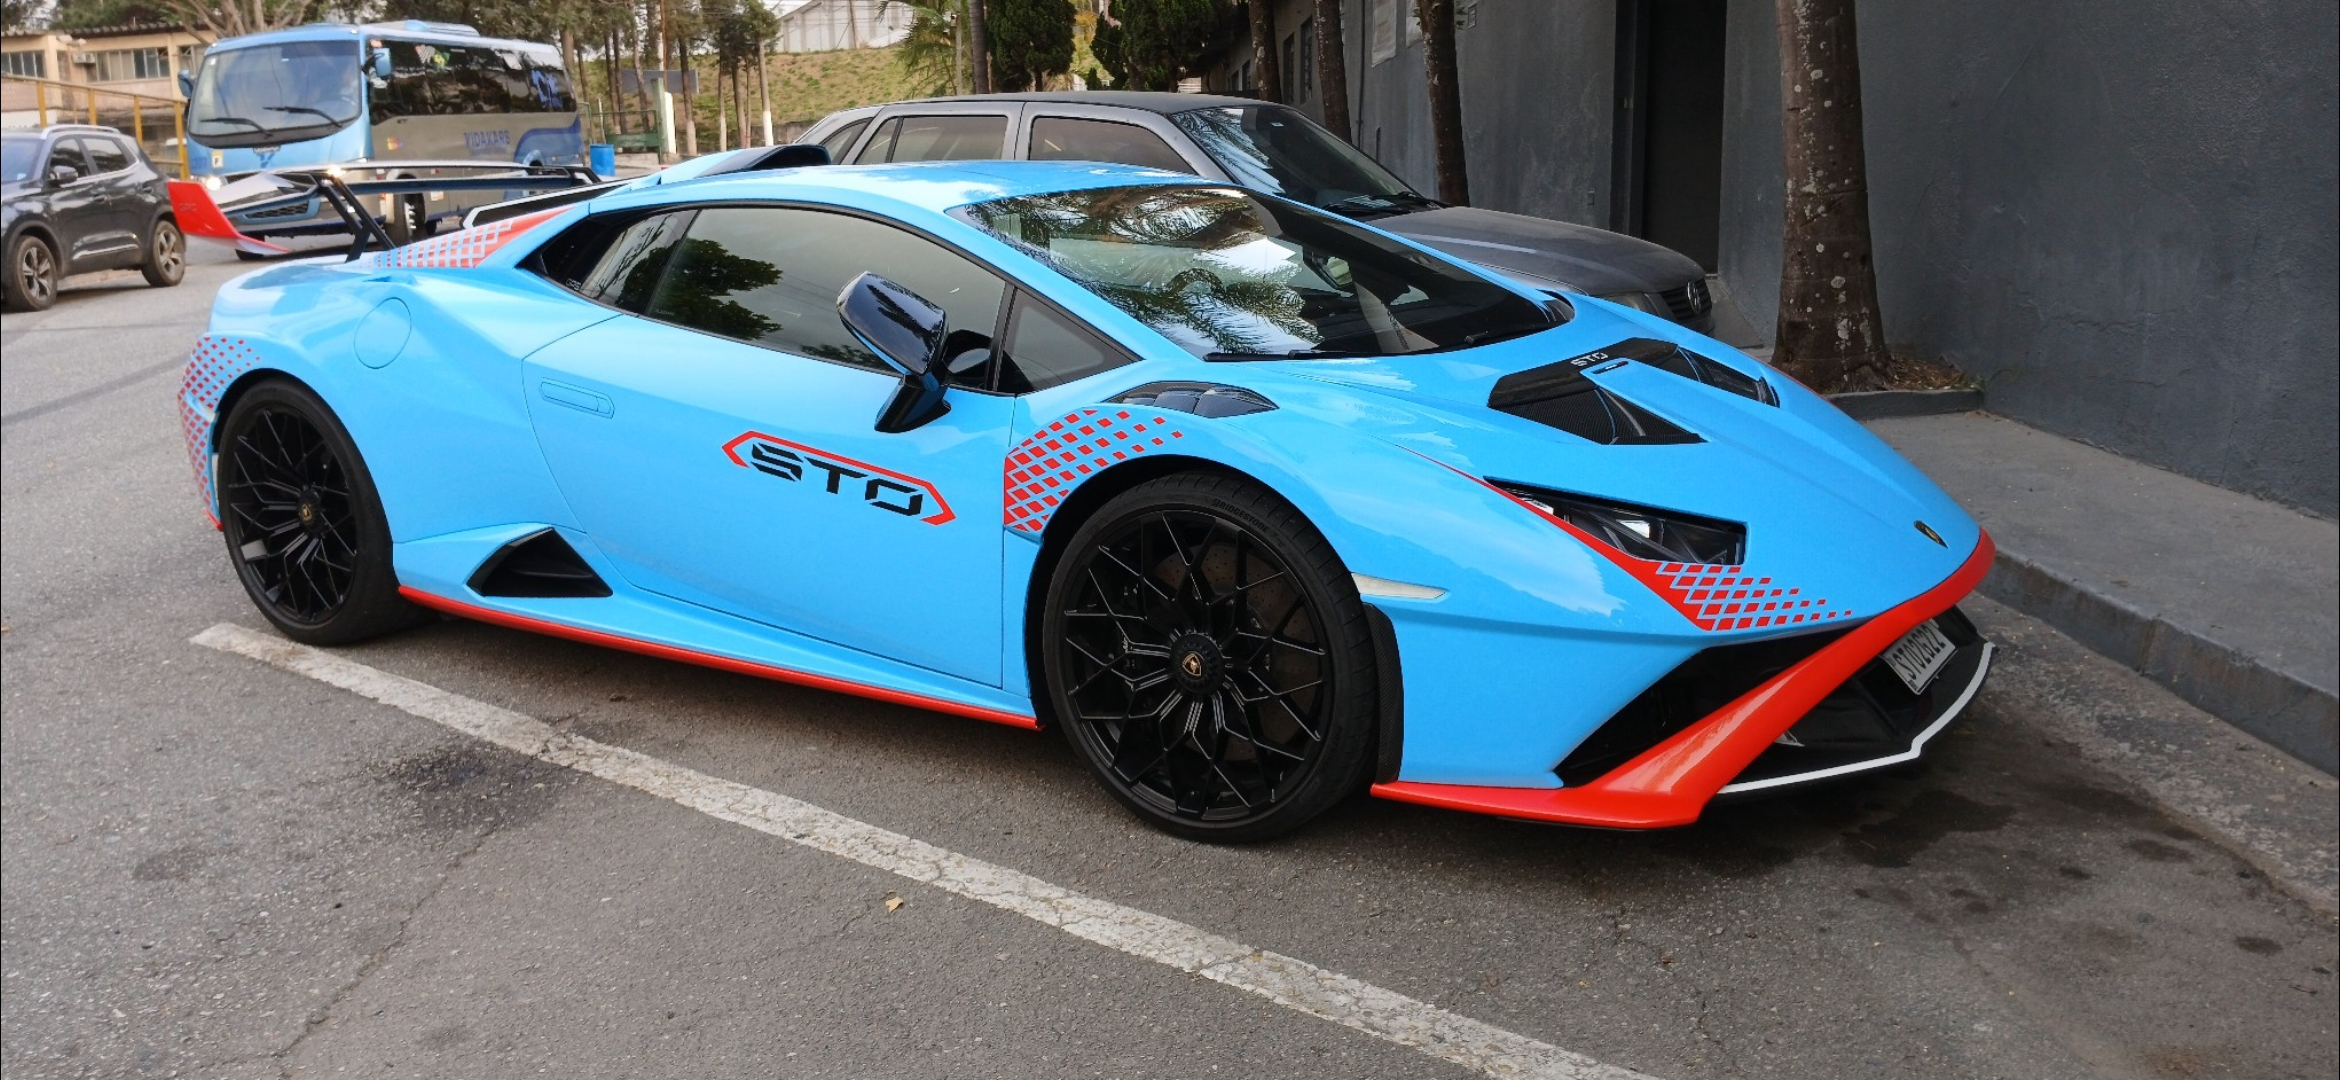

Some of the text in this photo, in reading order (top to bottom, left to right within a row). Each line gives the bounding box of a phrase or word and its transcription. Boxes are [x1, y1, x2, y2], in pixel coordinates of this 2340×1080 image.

[1570, 352, 1609, 367] STO
[750, 442, 924, 517] STO
[1211, 498, 1269, 533] BRIDGESTONE
[1892, 624, 1946, 680] STO2G22
